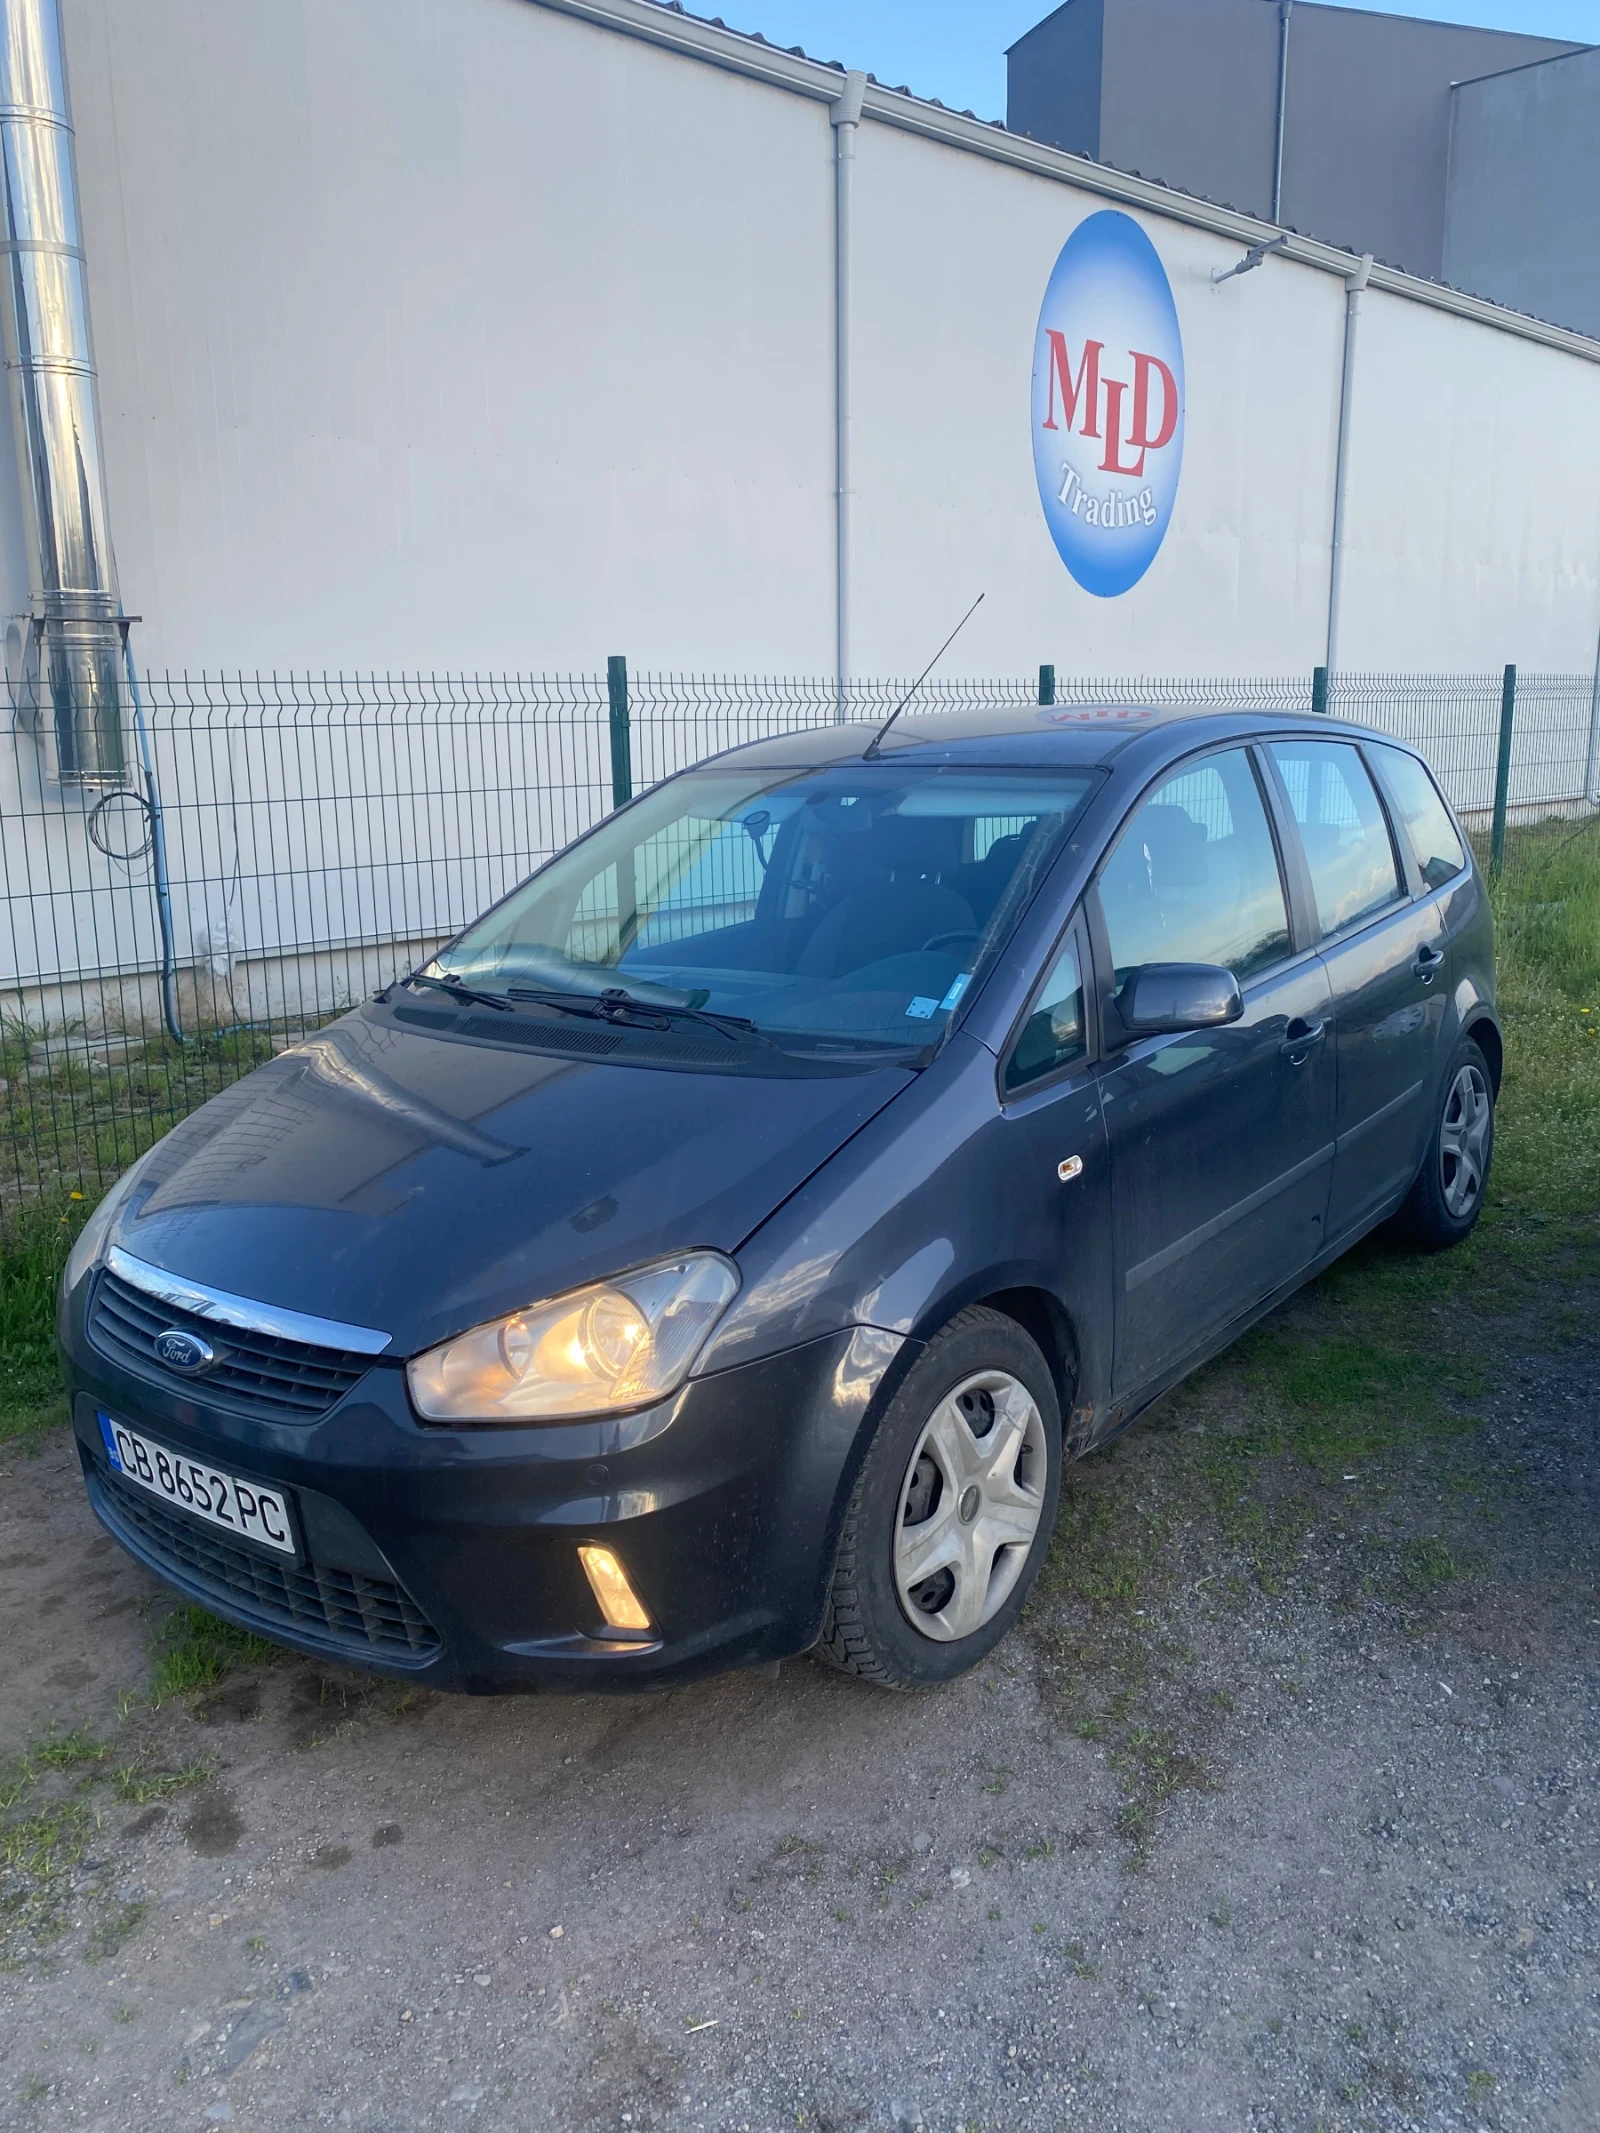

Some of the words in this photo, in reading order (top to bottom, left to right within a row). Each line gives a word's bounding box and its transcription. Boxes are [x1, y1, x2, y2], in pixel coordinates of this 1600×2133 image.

[1042, 329, 1178, 477] MLD
[1057, 463, 1157, 528] Trading
[162, 1338, 192, 1364] Ford
